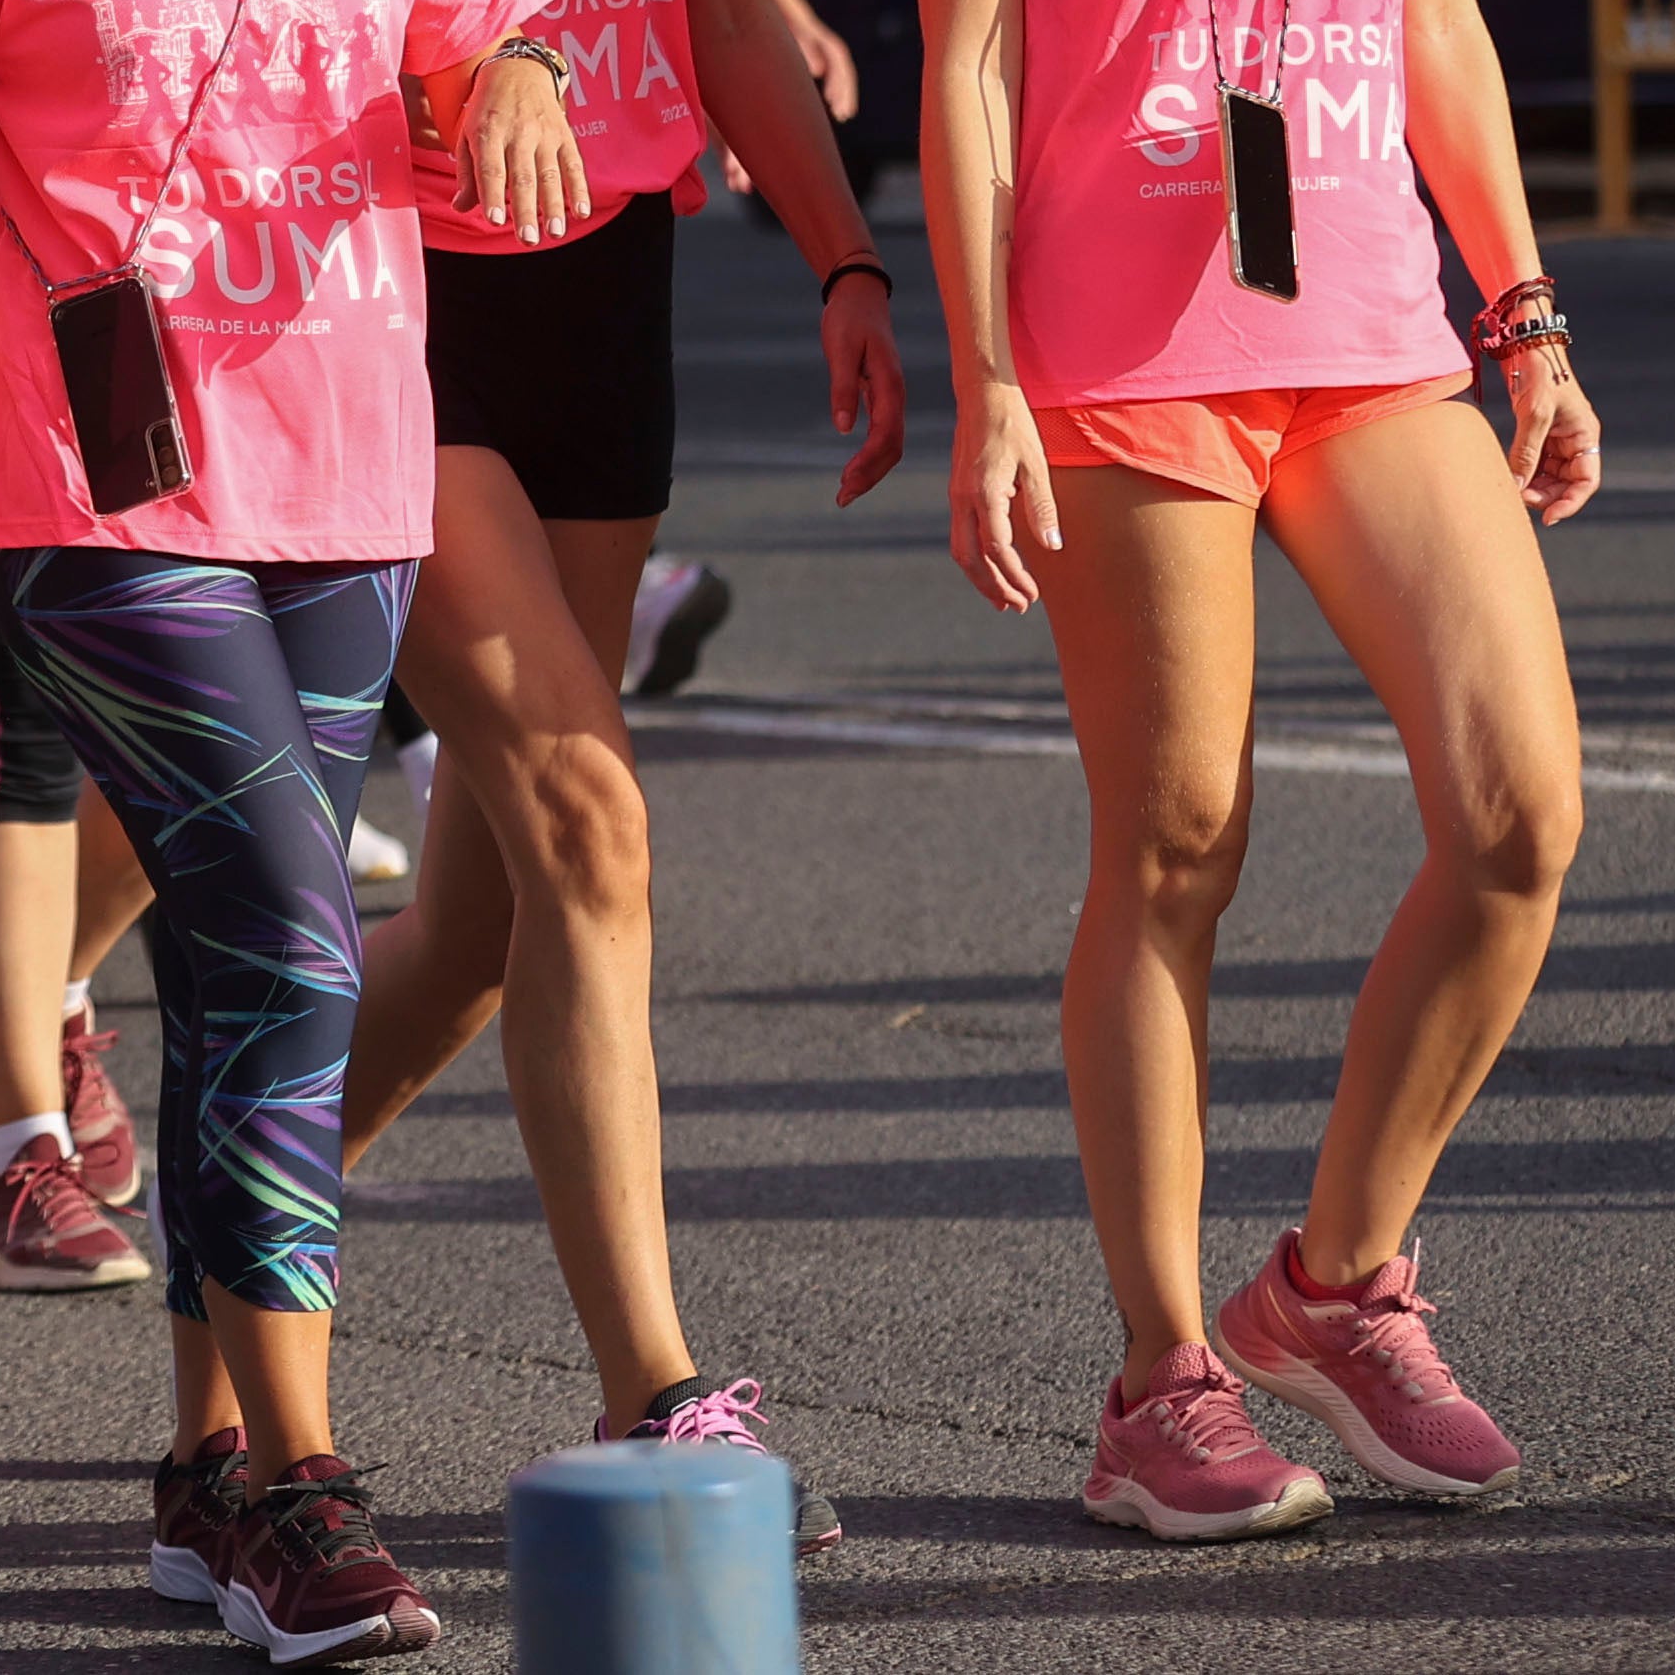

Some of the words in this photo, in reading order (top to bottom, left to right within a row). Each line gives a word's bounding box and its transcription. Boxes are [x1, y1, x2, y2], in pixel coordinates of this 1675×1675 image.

[558, 17, 680, 108] MA
[1148, 27, 1209, 72] TU
[1234, 23, 1396, 70] DORSA
[572, 120, 610, 139] UJER
[660, 102, 692, 124] 2022
[1139, 77, 1408, 167] SMA
[117, 173, 193, 214] TU
[213, 159, 381, 209] DORSL
[1139, 181, 1223, 199] CARRERA
[136, 218, 398, 305] SUMA
[157, 316, 216, 334] ARRERA
[220, 319, 244, 335] DE
[250, 320, 271, 336] LA
[276, 319, 332, 336] MUJER
